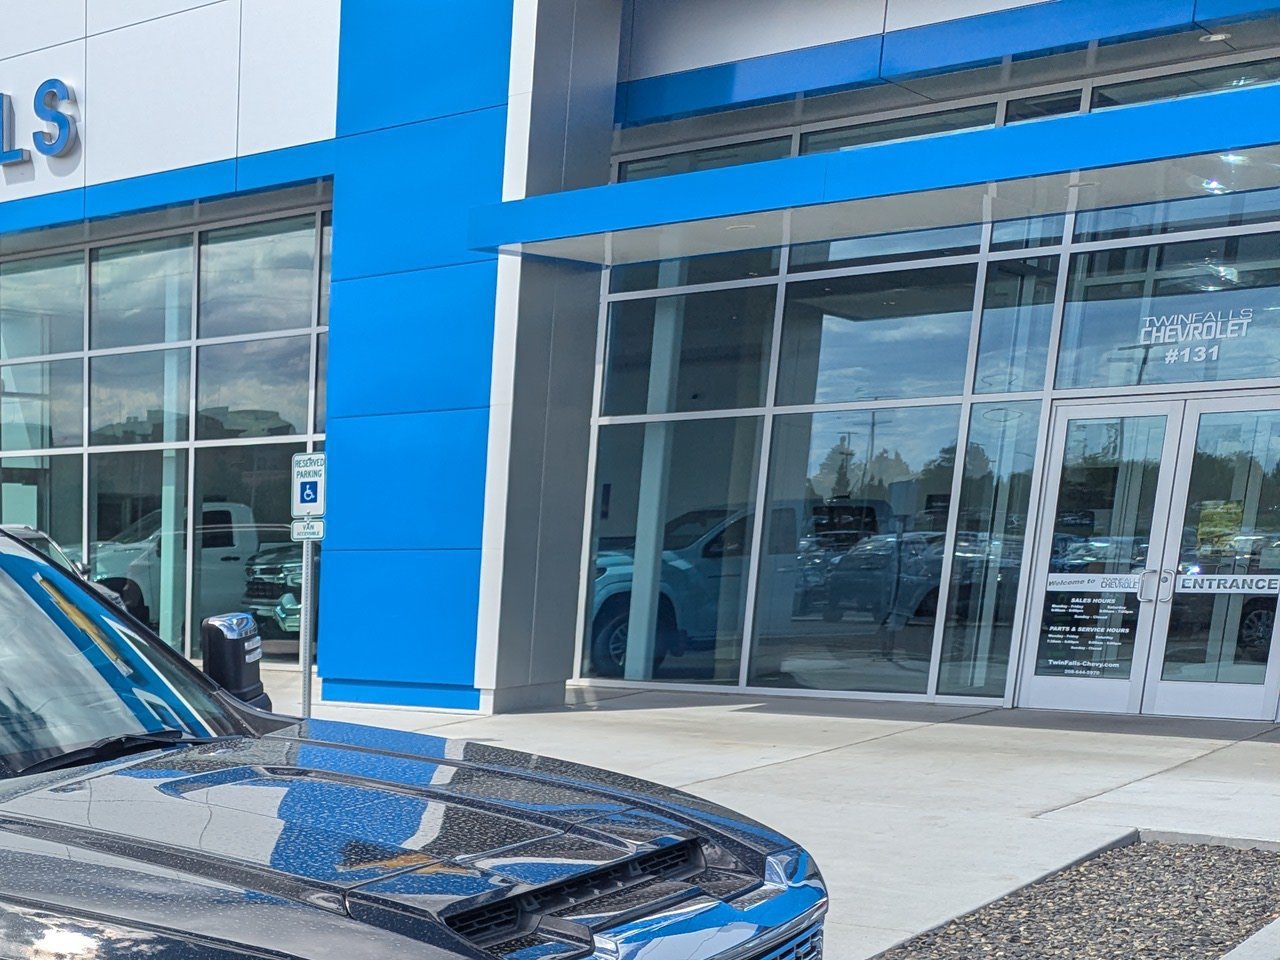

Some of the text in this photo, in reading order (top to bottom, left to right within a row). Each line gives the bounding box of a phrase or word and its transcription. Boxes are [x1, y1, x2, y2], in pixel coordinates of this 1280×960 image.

[1140, 319, 1252, 344] CHEVROLET
[1165, 345, 1219, 364] #131
[294, 458, 325, 468] RESERVED
[296, 469, 322, 478] PARKING
[1048, 578, 1085, 586] Welcome
[1100, 581, 1139, 589] CHEVROLE
[1181, 578, 1278, 590] ENTRANCE
